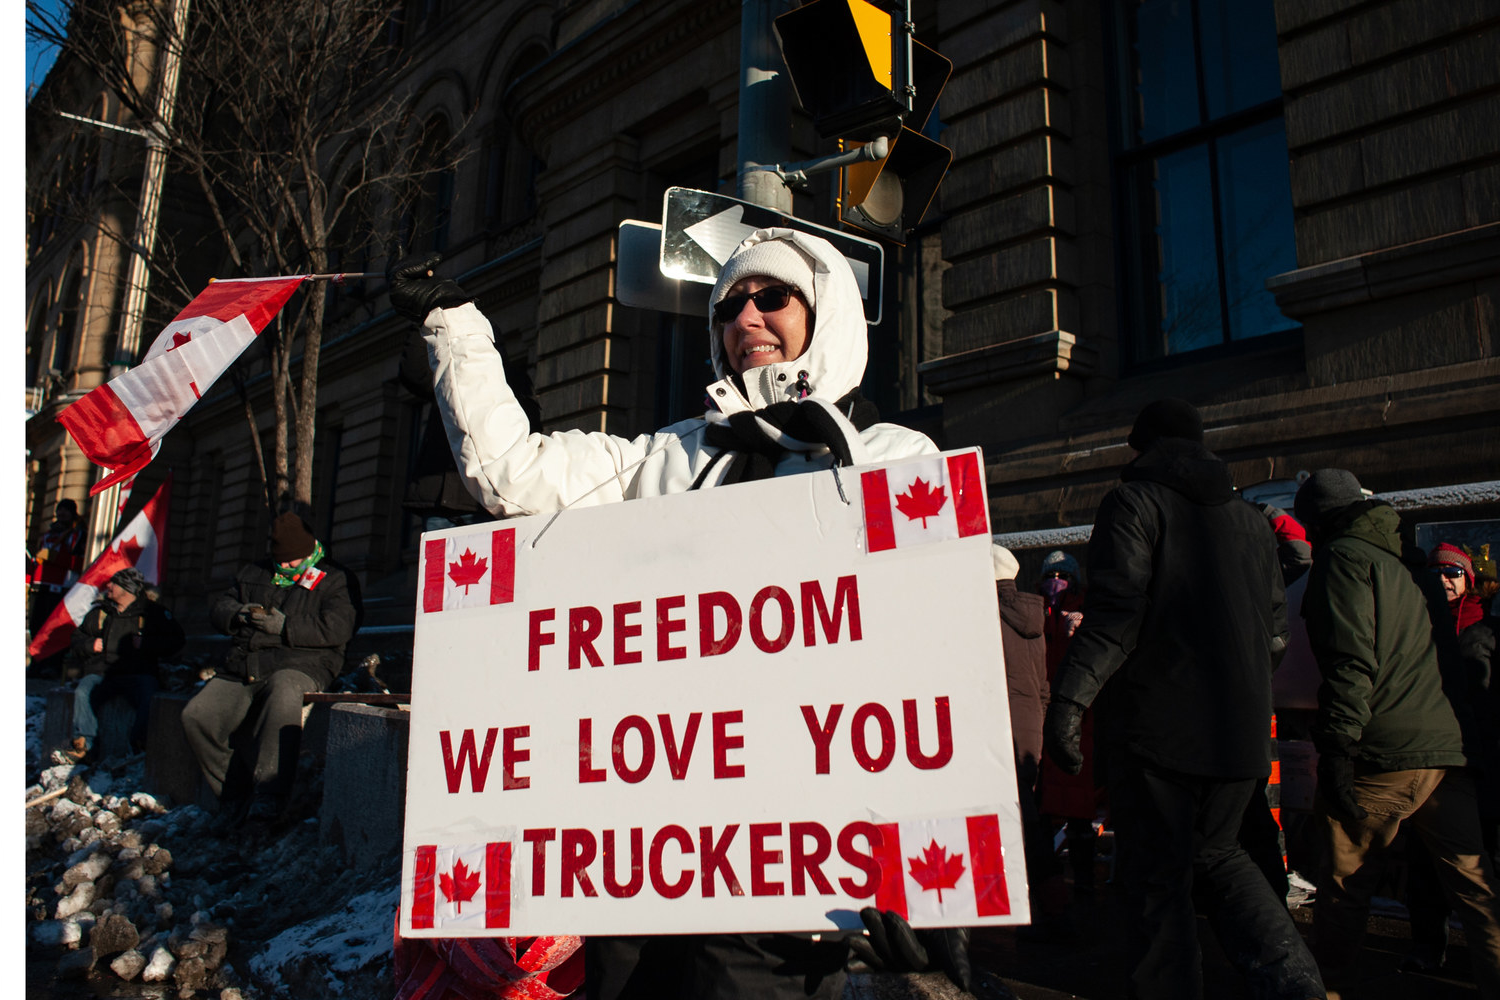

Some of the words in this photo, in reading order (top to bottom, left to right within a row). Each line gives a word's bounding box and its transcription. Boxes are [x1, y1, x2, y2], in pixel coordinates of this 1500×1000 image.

[527, 574, 863, 672] FREEDOM
[439, 725, 531, 794] WE
[578, 709, 746, 784] LOVE
[800, 695, 954, 775] YOU
[523, 820, 885, 899] TRUCKERS
